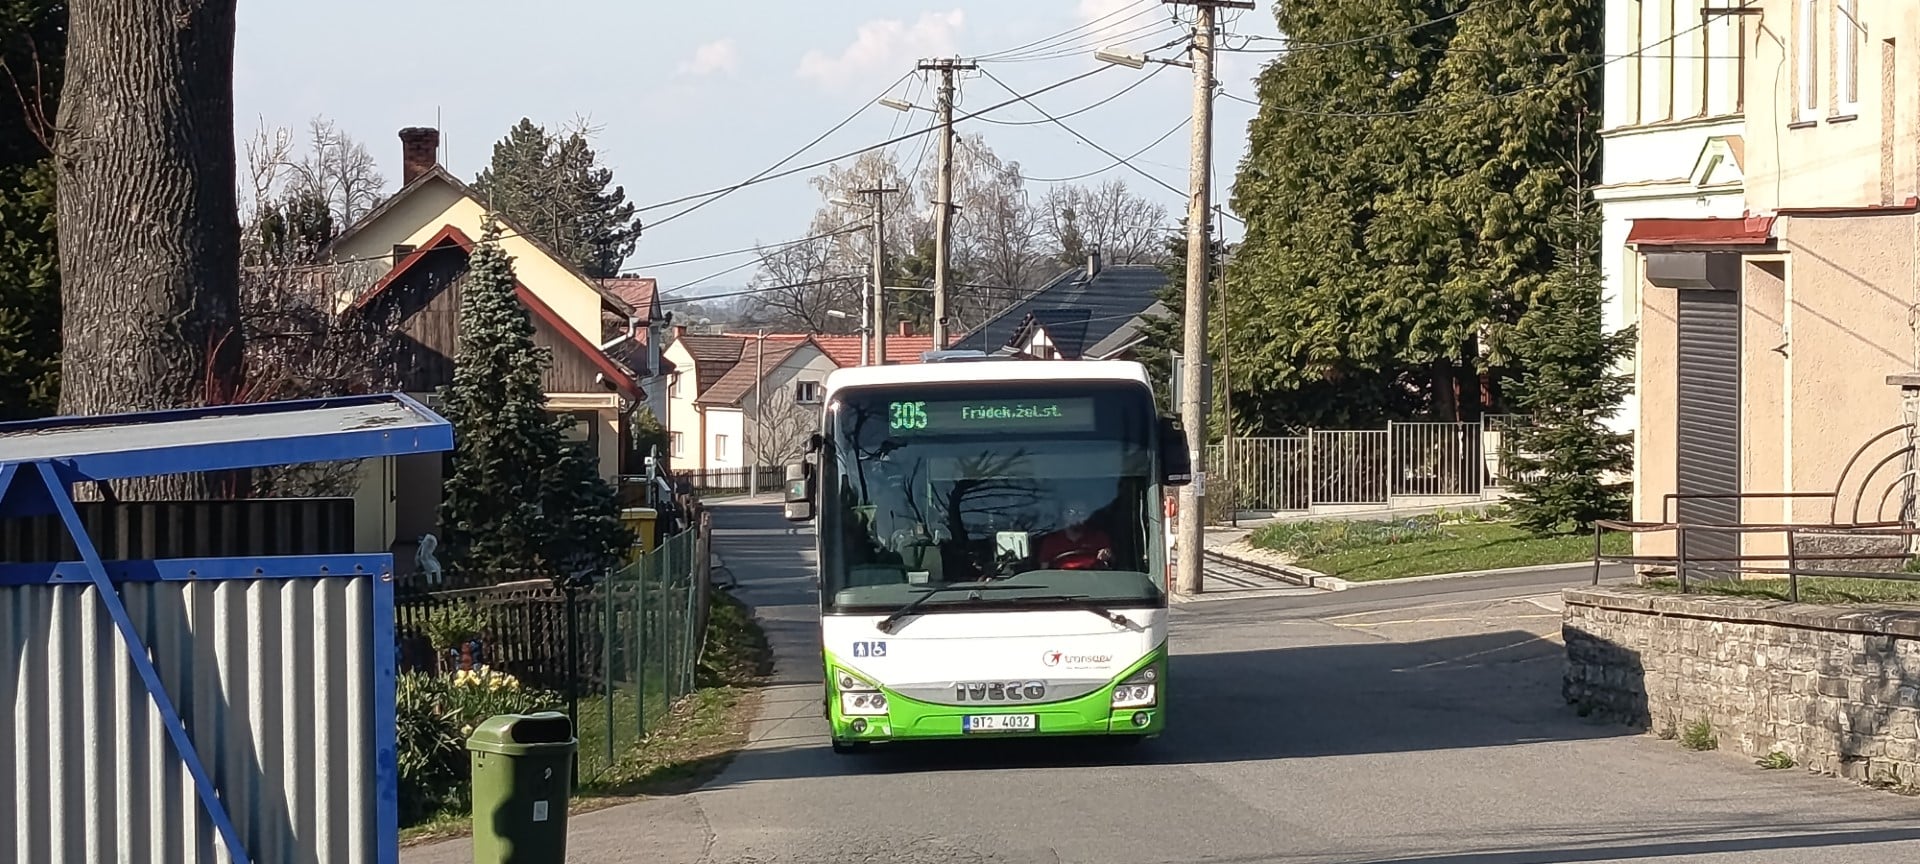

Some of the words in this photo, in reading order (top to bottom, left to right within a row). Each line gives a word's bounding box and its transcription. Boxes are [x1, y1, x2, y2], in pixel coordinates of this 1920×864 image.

[890, 402, 928, 429] 305
[956, 681, 1045, 701] IVECO
[972, 717, 994, 728] 9T2
[1002, 716, 1030, 728] 4032
